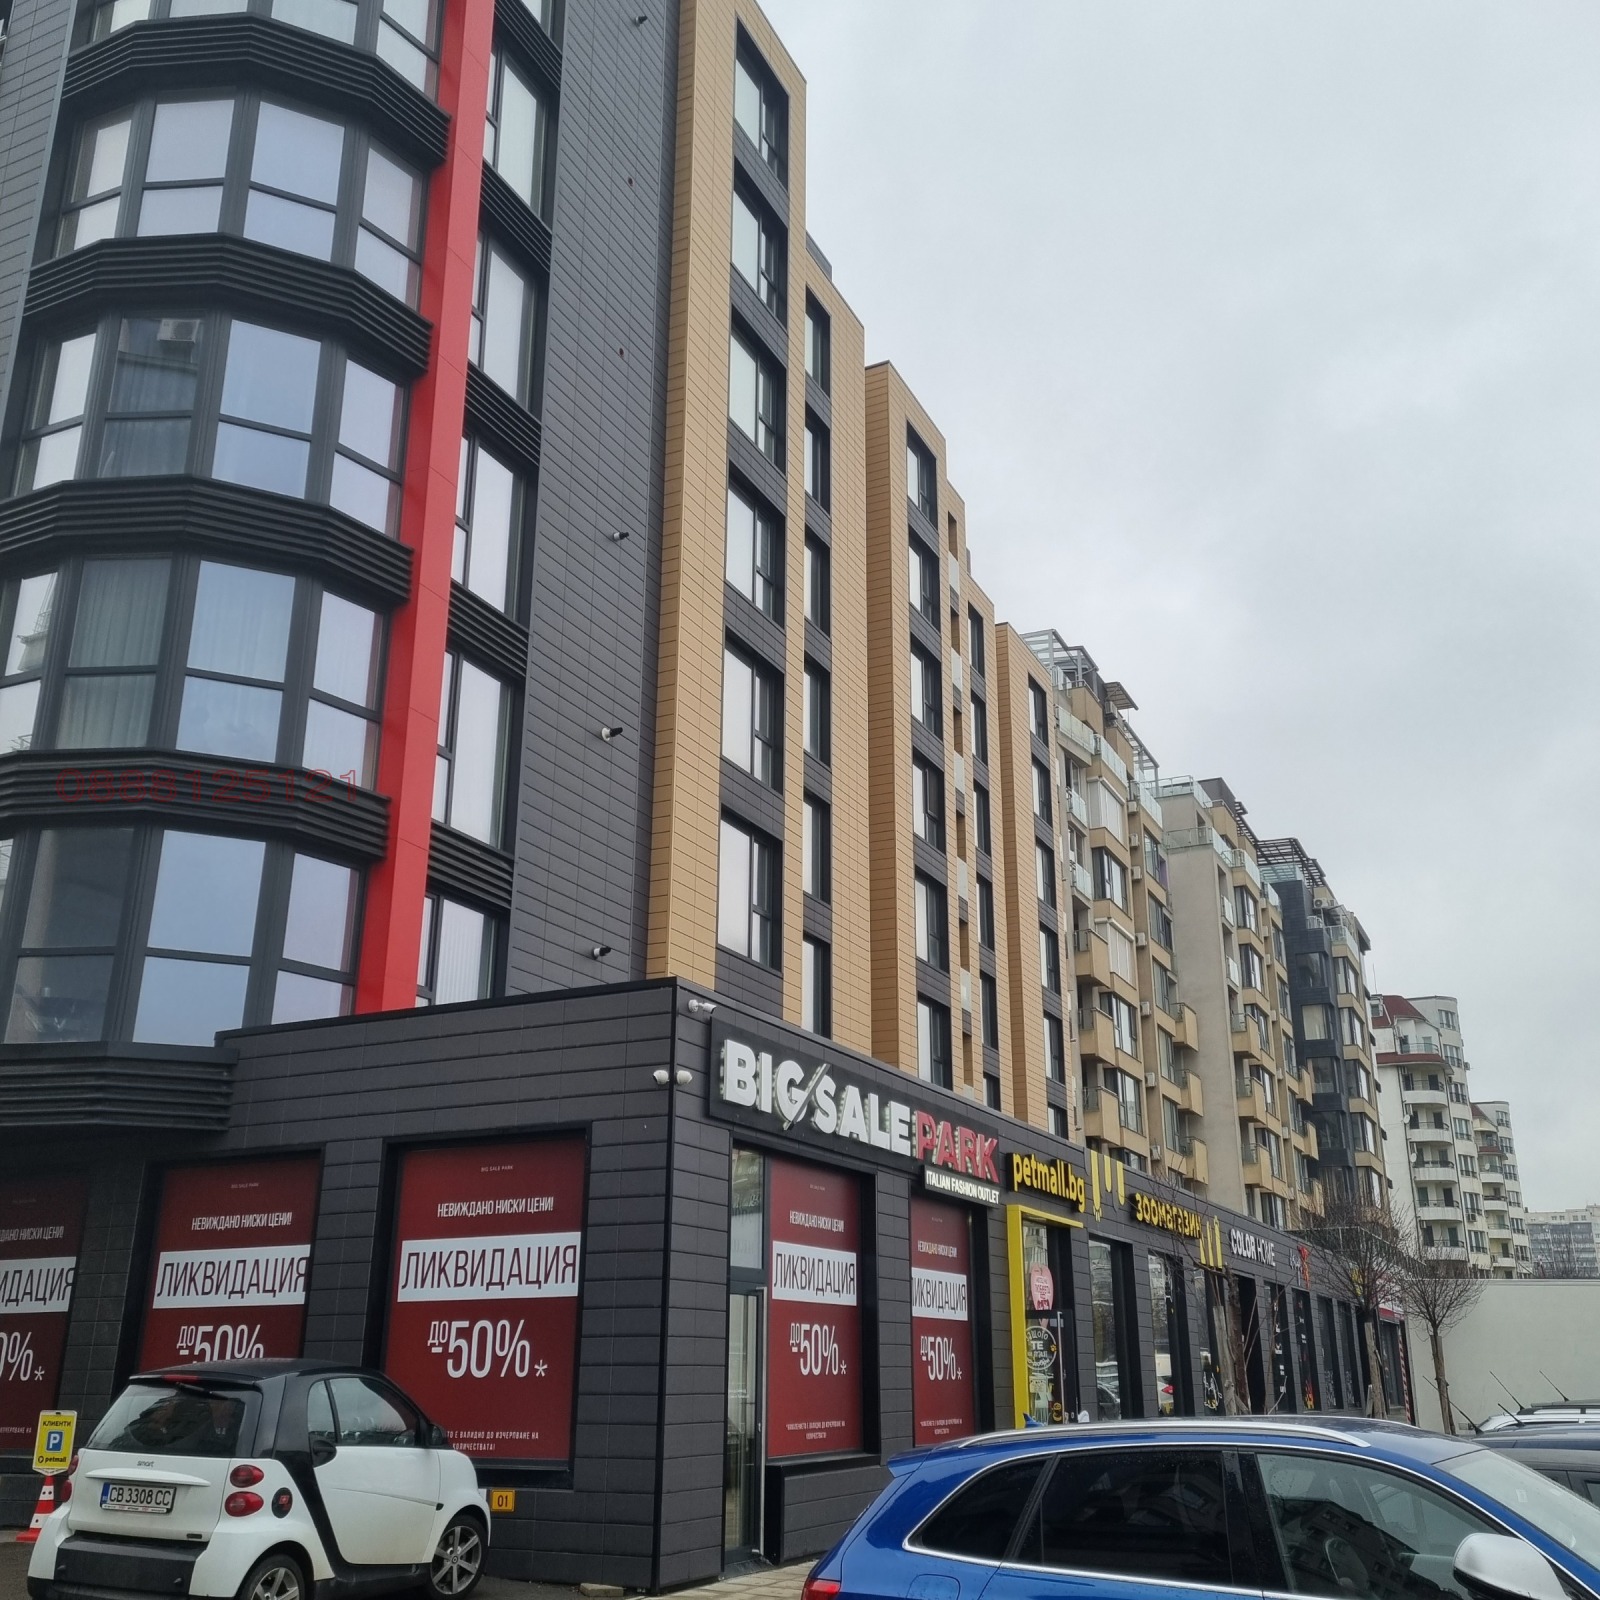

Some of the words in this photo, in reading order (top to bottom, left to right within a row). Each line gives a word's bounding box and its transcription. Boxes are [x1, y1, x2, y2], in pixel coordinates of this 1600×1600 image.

[912, 1110, 999, 1183] PARK
[926, 1170, 951, 1191] ITALIAN
[951, 1177, 977, 1198] FASHION
[977, 1186, 1000, 1204] OUTLET
[1012, 1152, 1086, 1213] petmall.bg
[191, 1214, 241, 1231] НЕВИЖДАНО
[241, 1213, 268, 1229] НИСКИ
[268, 1211, 293, 1228] ЦЕНИ!
[437, 1200, 494, 1218] НЕВИЖДАНО
[495, 1198, 526, 1214] НИСКИ
[527, 1196, 554, 1214] ЦЕНИ!
[19, 1226, 43, 1241] НИСКИ
[1230, 1228, 1257, 1260] COLOR
[1257, 1237, 1276, 1267] HOME
[157, 1256, 309, 1299] ЛИКВИДАЦИЯ
[401, 1244, 577, 1292] ЛИКВИДАЦИЯ
[774, 1252, 856, 1297] ЛИКВИДАЦИЯ
[531, 1431, 539, 1440] НА
[137, 1460, 155, 1468] smart
[109, 1487, 125, 1503] CB
[125, 1488, 154, 1505] 3308
[155, 1490, 171, 1506] CC
[497, 1494, 509, 1508] 01
